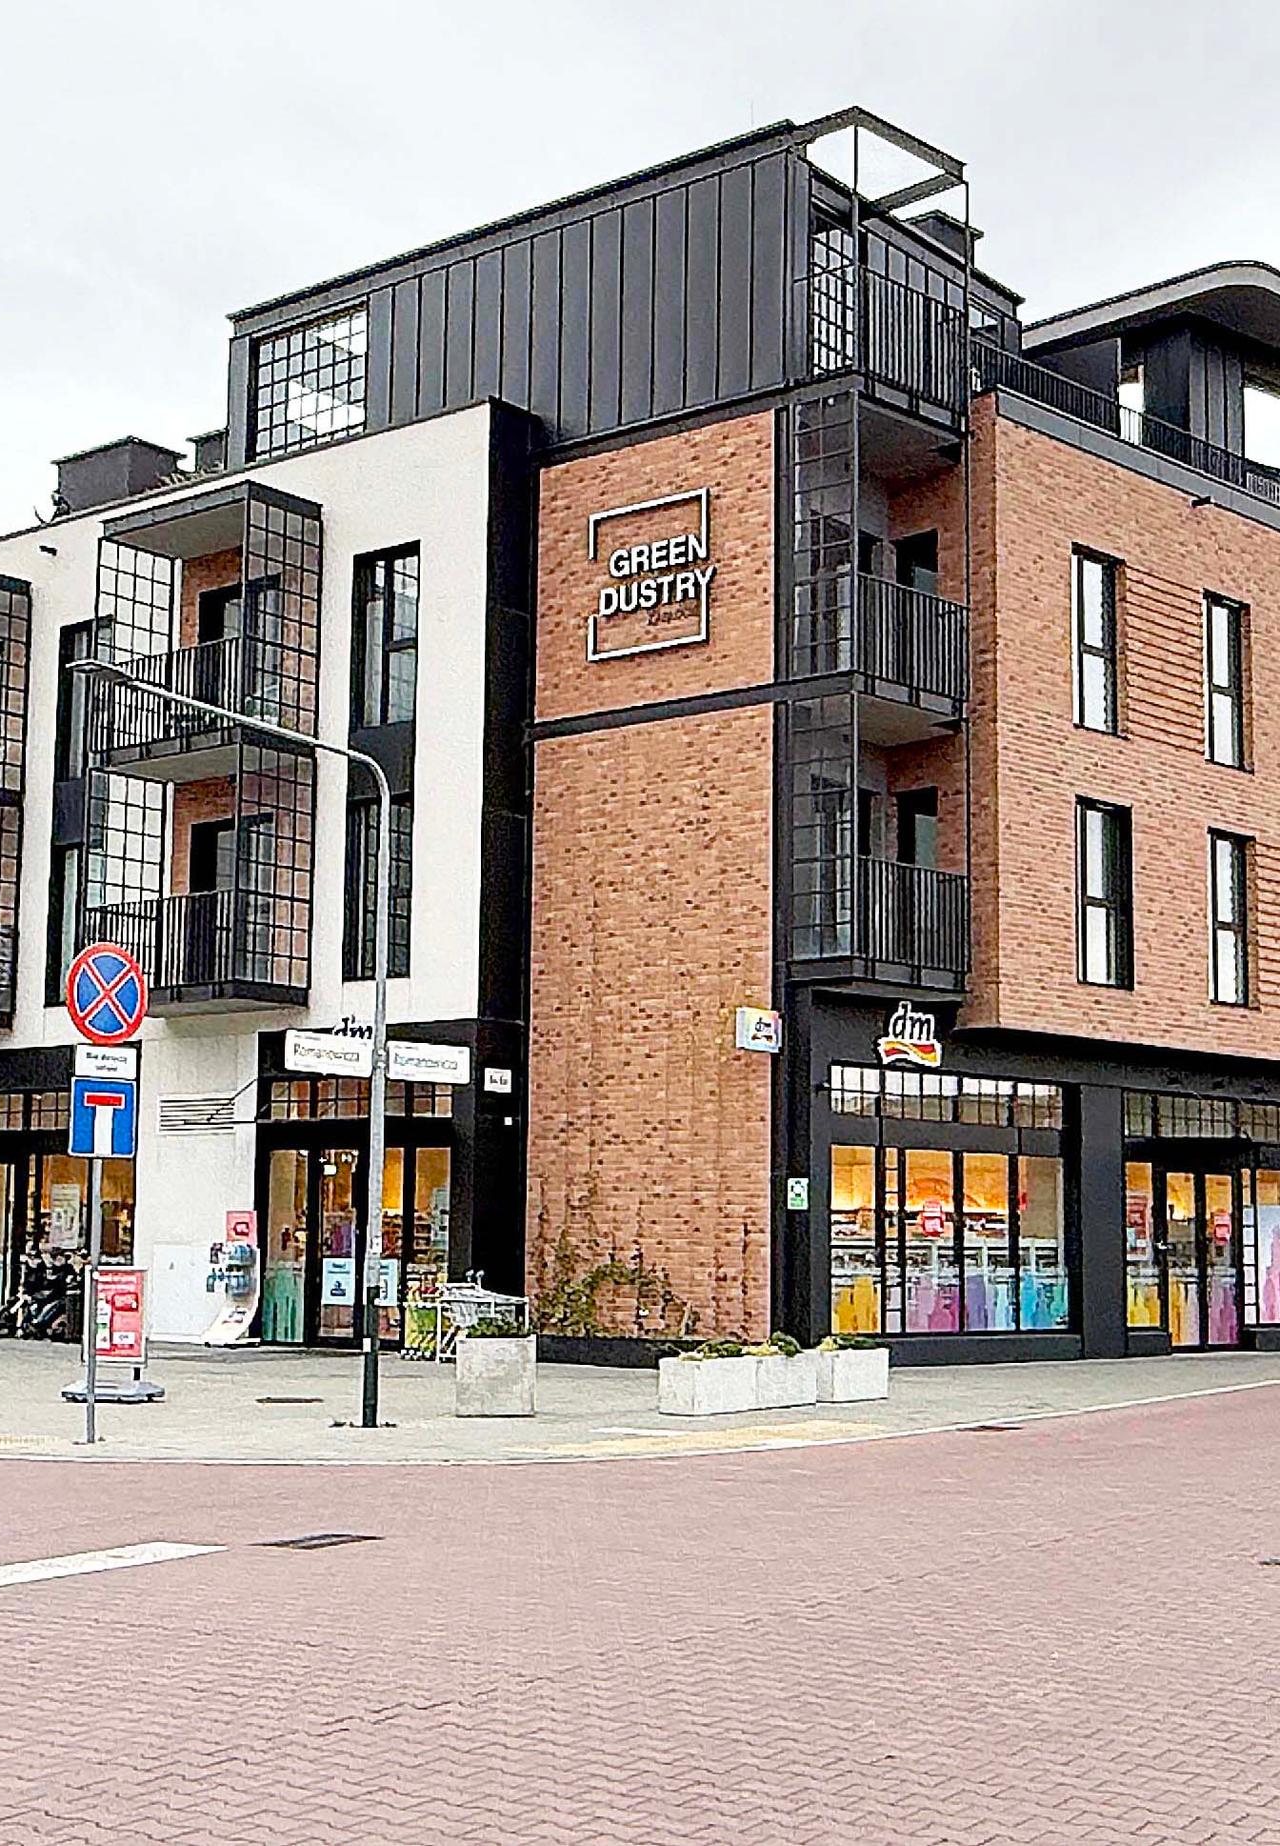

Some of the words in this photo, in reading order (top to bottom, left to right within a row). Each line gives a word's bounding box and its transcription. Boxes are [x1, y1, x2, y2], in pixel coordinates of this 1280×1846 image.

[609, 534, 707, 577] GREEN
[599, 565, 717, 616] DUSTRY
[334, 1014, 373, 1040] dm
[754, 1017, 772, 1033] dm
[891, 1003, 933, 1040] dm
